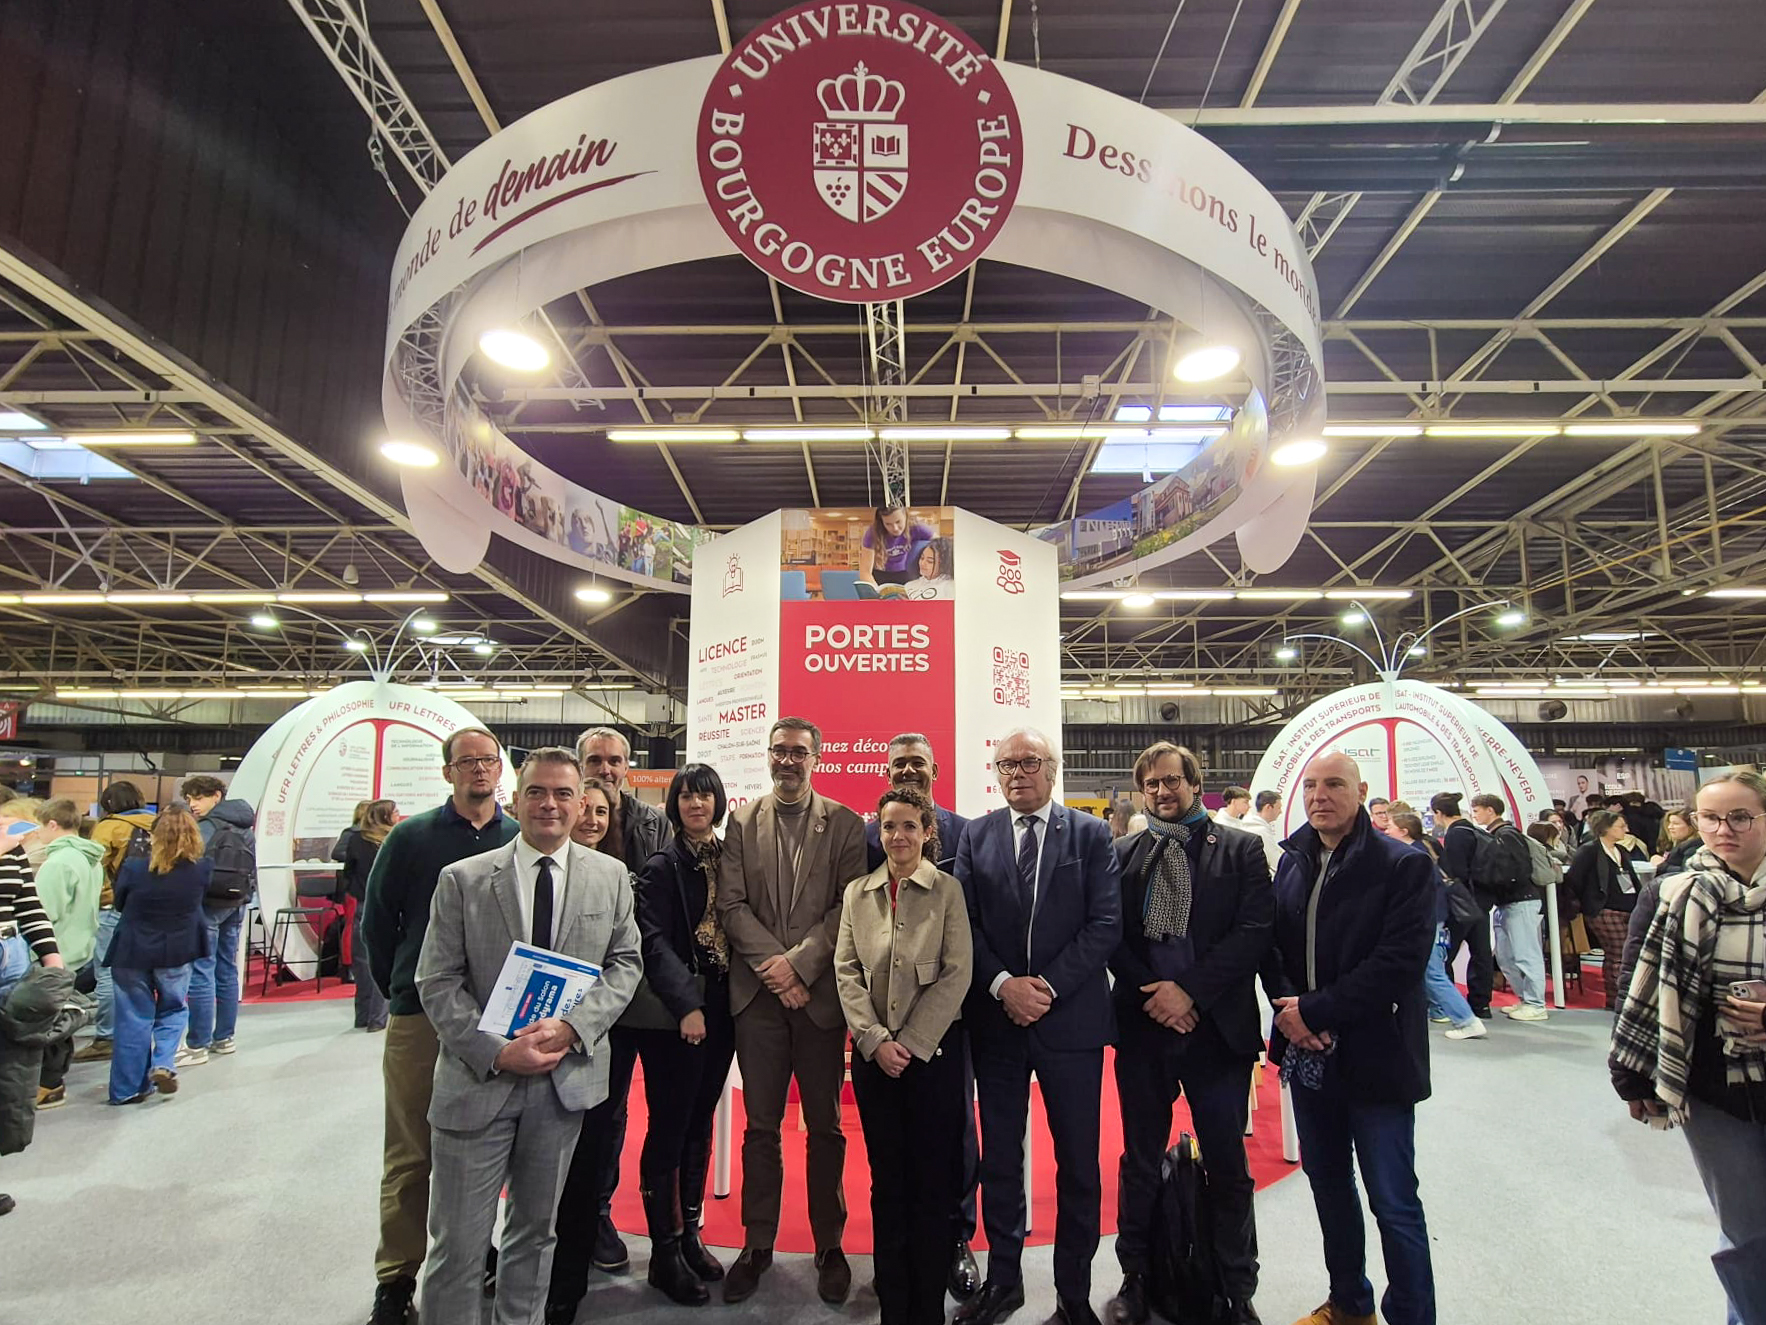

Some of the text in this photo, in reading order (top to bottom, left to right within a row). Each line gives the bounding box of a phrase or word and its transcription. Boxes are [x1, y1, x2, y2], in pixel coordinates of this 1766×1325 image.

[731, 3, 989, 86] UNIVERSITÉ
[448, 197, 477, 240] de
[483, 133, 618, 220] demain
[709, 109, 1012, 289] BOURGOGNE EUROPE
[1063, 123, 1238, 233] Dessnons
[1249, 214, 1267, 256] le
[698, 636, 747, 663] LICENCE
[805, 624, 930, 649] PORTES
[804, 653, 930, 672] OUVERTES
[389, 701, 457, 732] UFR LETTRES
[719, 703, 766, 725] MASTER
[1288, 717, 1318, 747] INSTITUT
[1318, 695, 1366, 720] SUPERIEUR
[1368, 692, 1381, 700] DE
[1412, 691, 1439, 709] INSTITUT
[1438, 705, 1472, 745] SUPERIEUR
[1469, 745, 1479, 760] DE
[698, 729, 730, 741] RÉUSSITE
[820, 738, 889, 753] nez déco
[1440, 724, 1452, 740] DES
[278, 778, 291, 803] UFR
[289, 731, 316, 778] LETTRES
[322, 700, 374, 727] PHILOSOPHIE
[1276, 746, 1306, 793] UTOMOBILE
[1309, 728, 1326, 742] DES
[1325, 705, 1381, 730] TRANSPORTS
[847, 763, 889, 777] camp
[539, 984, 558, 1020] dyrama
